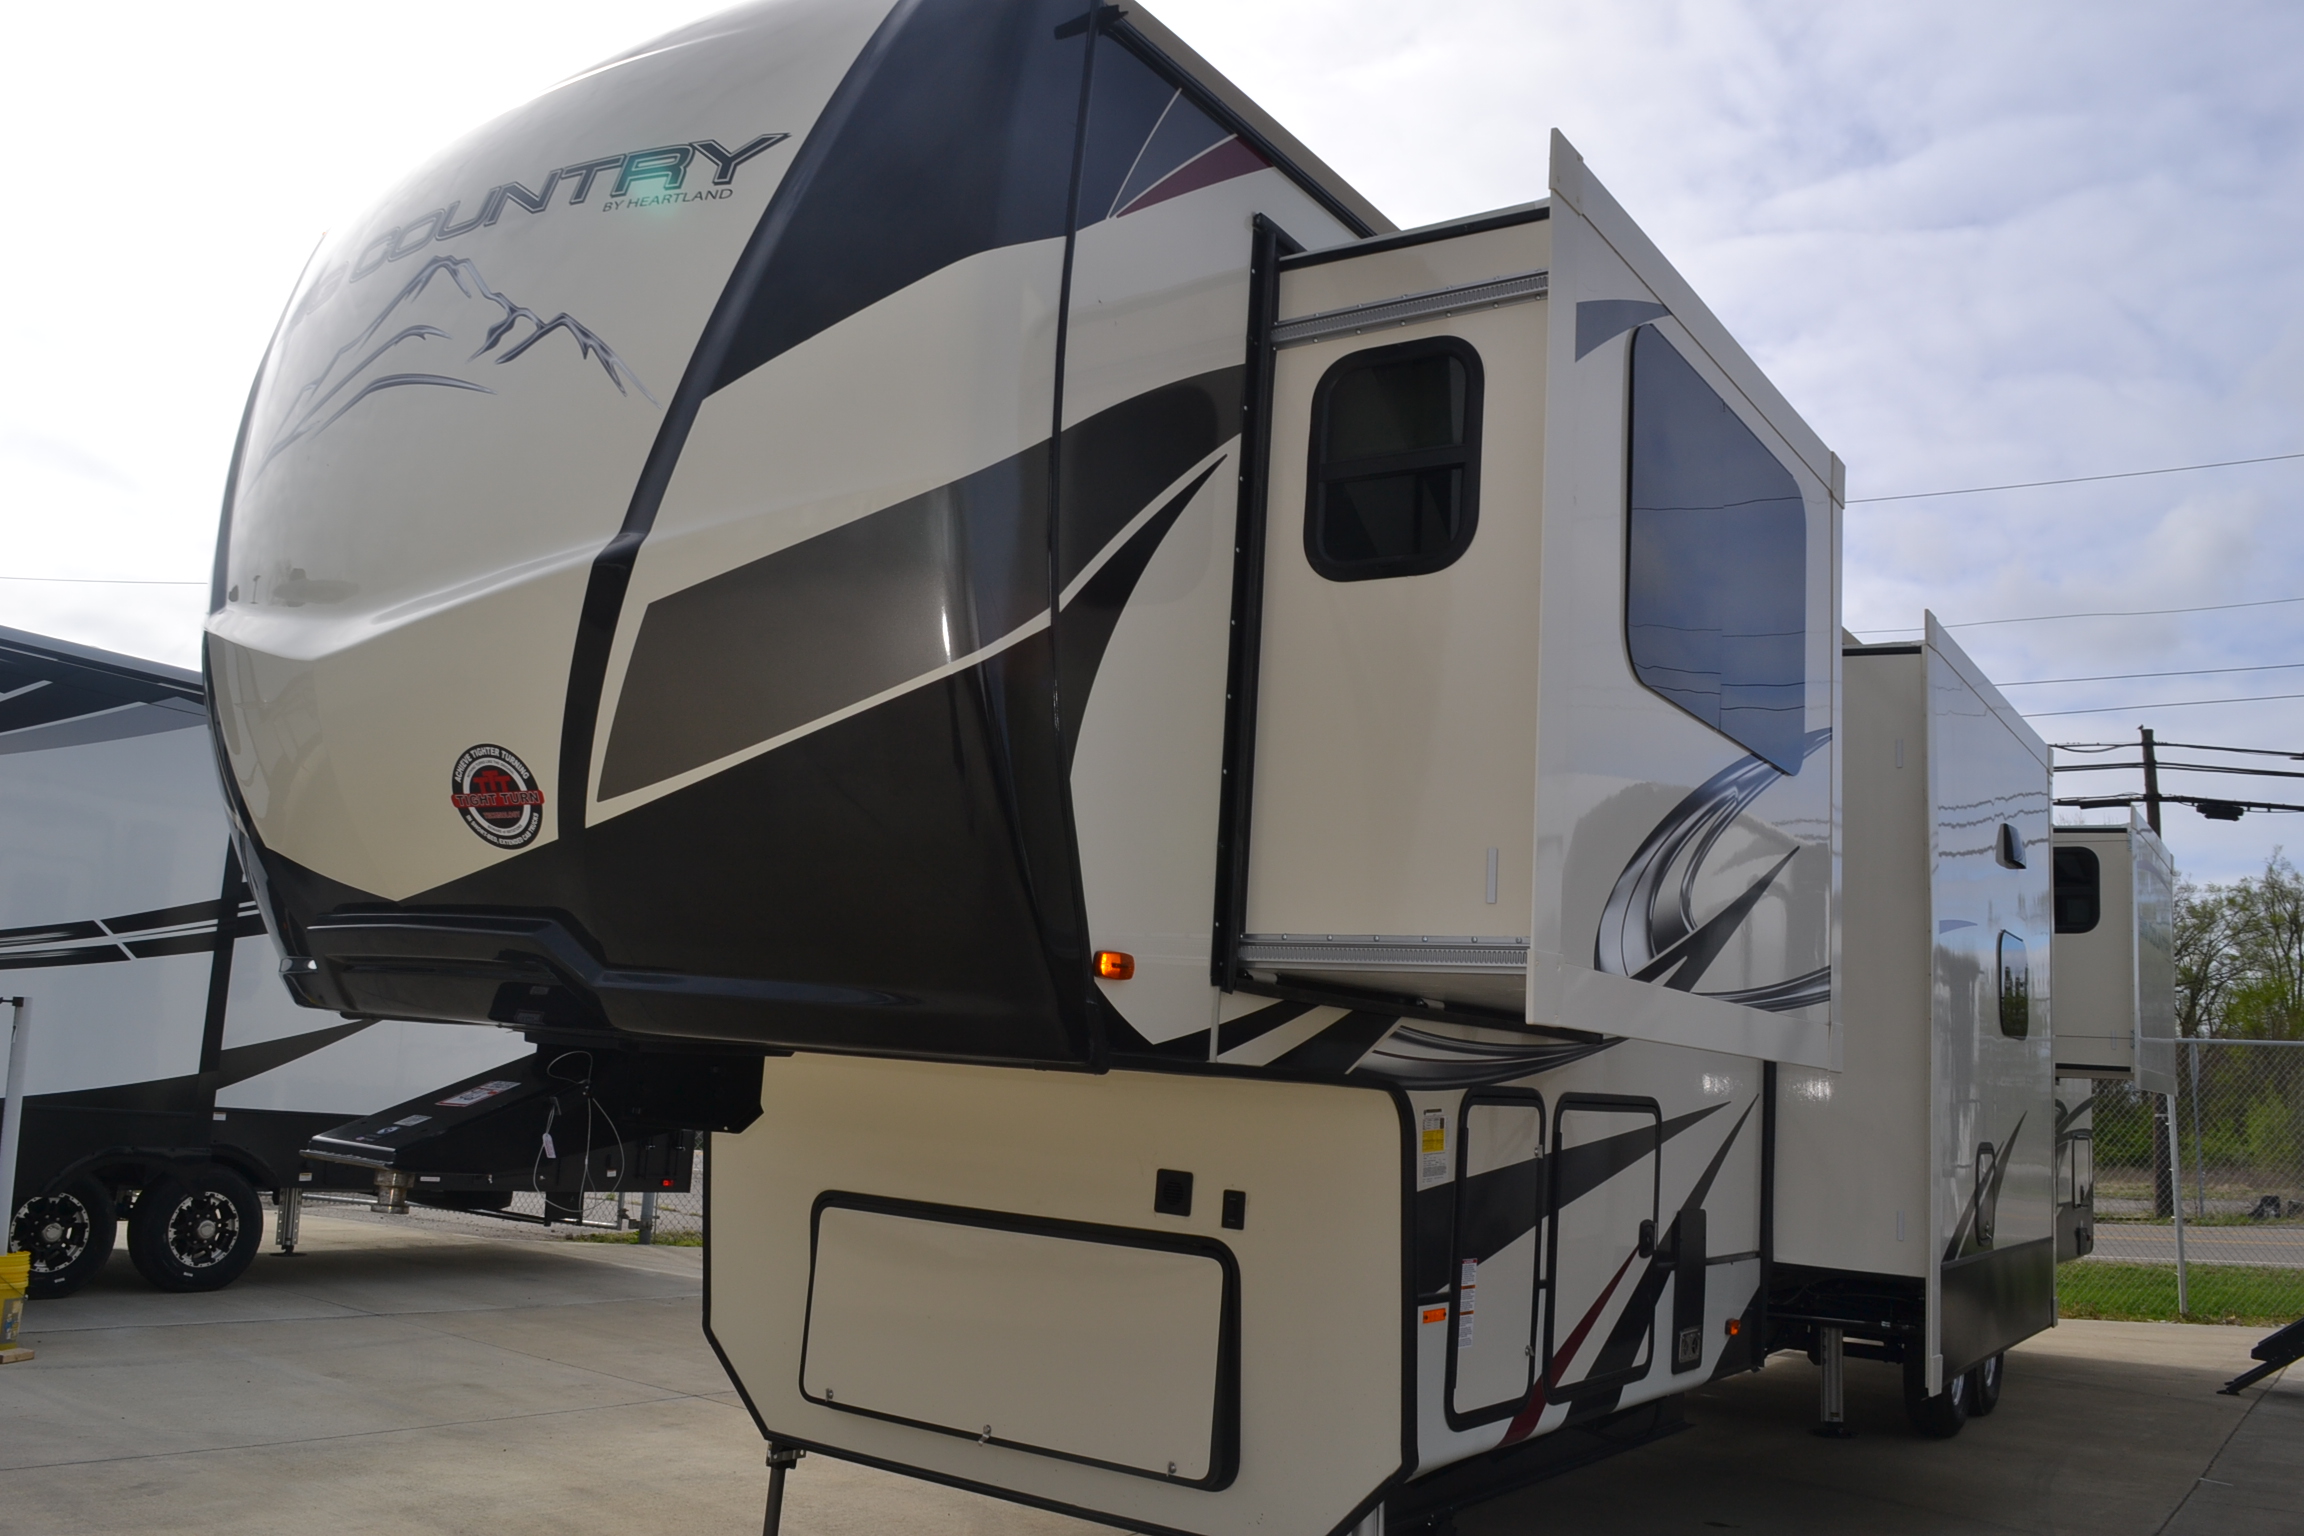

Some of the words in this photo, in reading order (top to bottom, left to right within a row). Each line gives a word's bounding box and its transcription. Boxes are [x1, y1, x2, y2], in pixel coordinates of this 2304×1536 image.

[348, 132, 791, 283] COUNTRY
[602, 200, 624, 212] BY
[626, 188, 733, 208] HEARTLAND
[454, 754, 472, 782] ACHIEVE
[470, 747, 500, 757] TIGHTER
[501, 750, 530, 779] TURNING
[456, 793, 497, 806] TIGHT
[500, 791, 540, 805] TURN
